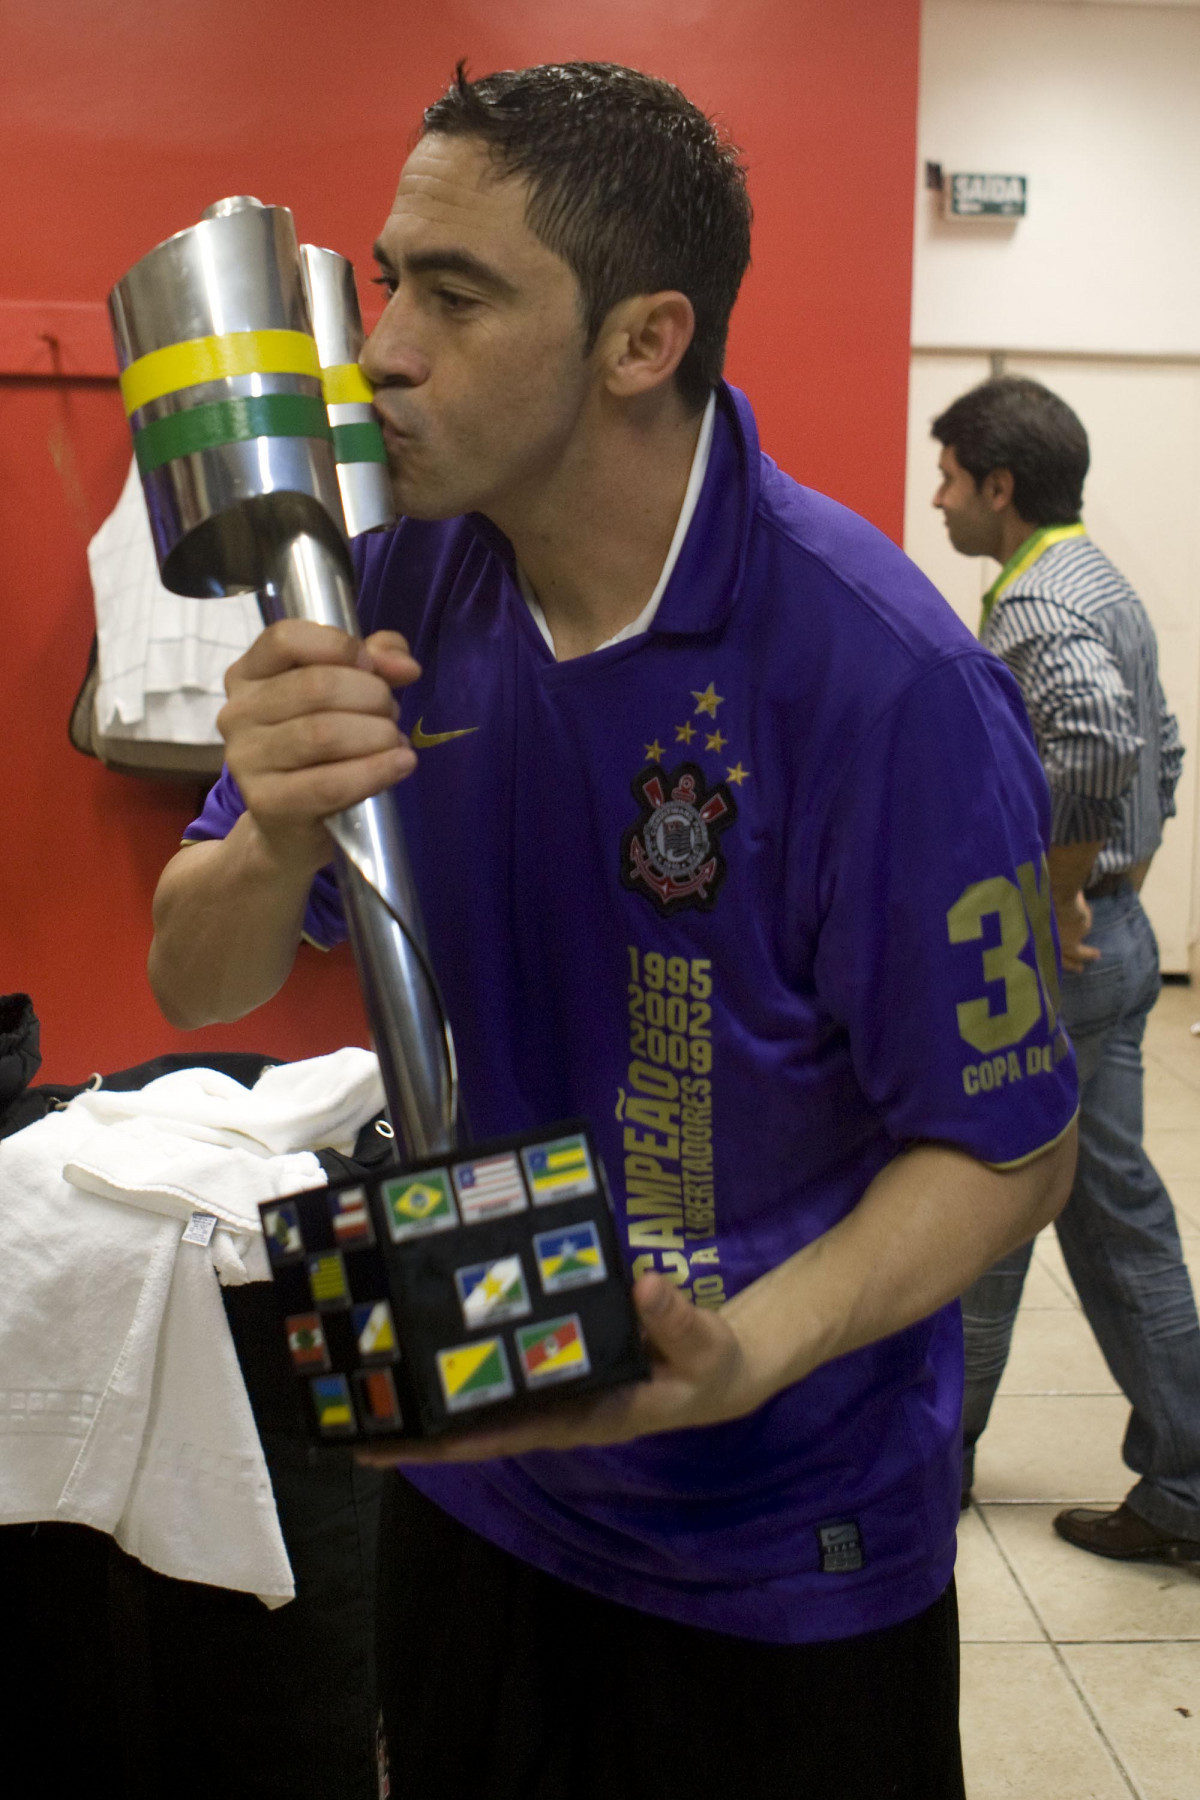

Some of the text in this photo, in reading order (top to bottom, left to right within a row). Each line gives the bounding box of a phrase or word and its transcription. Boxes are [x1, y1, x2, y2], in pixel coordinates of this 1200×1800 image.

[627, 945, 713, 999] 1995
[627, 984, 713, 1037] 2002
[629, 1020, 713, 1075] 2009
[961, 1050, 1023, 1096] COPA
[615, 1058, 692, 1300] CAMPEÃO
[680, 1075, 716, 1241] LIBERTADORES
